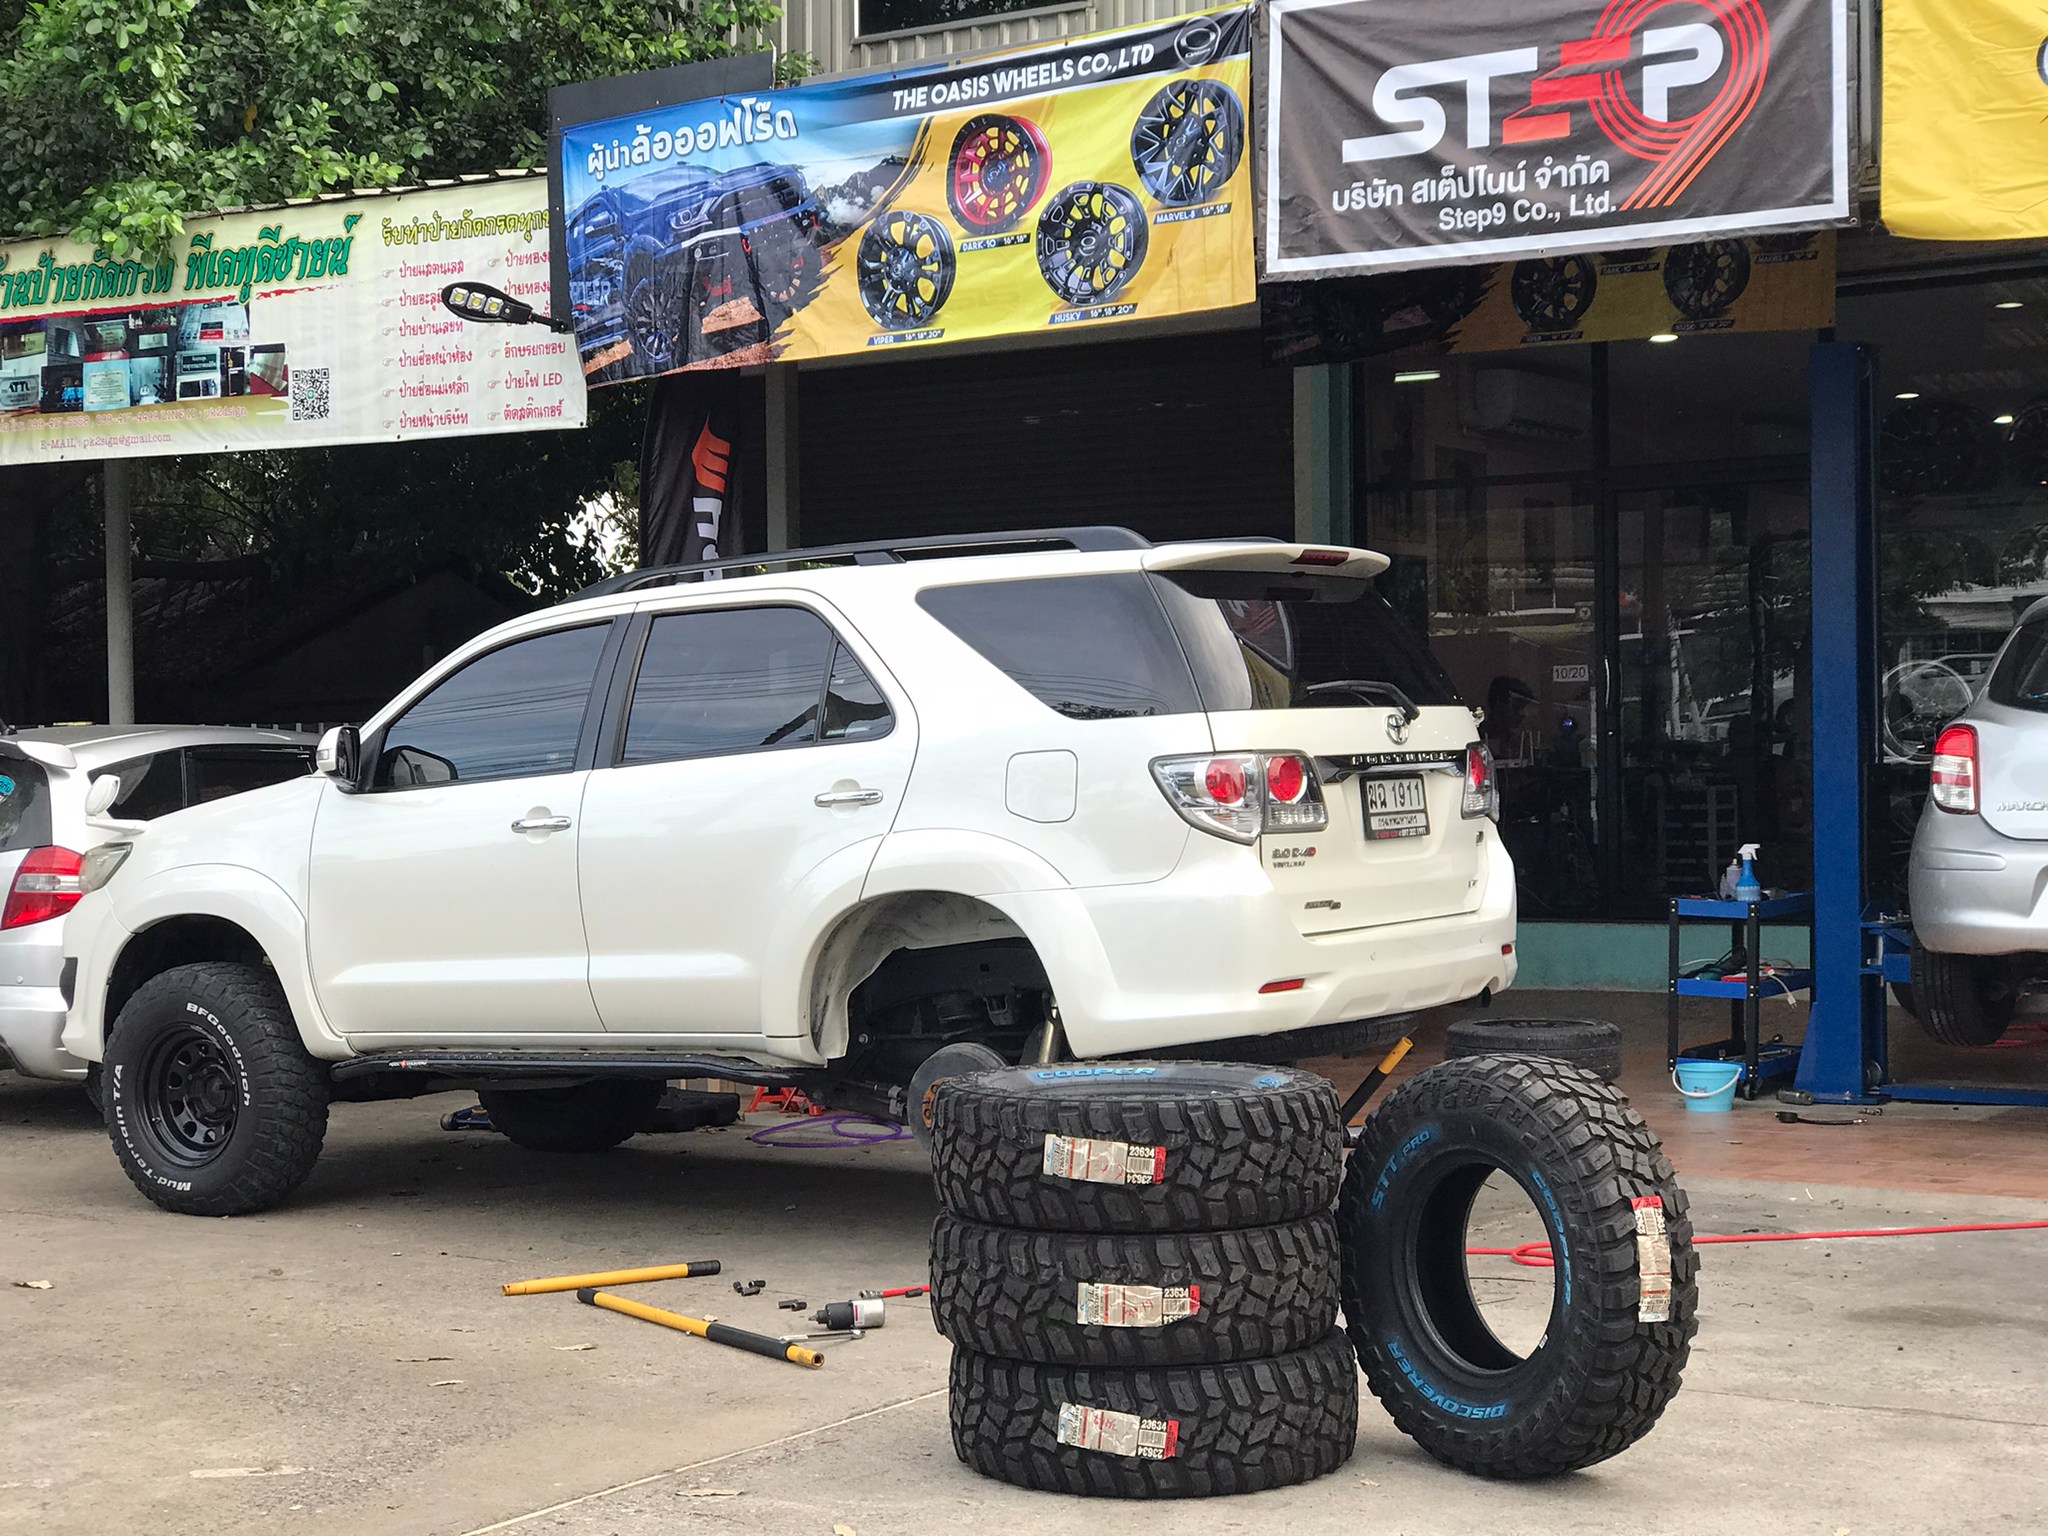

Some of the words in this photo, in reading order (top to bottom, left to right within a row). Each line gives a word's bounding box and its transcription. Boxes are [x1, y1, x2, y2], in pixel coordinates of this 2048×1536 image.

[892, 86, 928, 111] THE
[931, 77, 989, 105] OASIS
[993, 60, 1074, 95] WHEELS
[1077, 43, 1155, 80] CO.,LTD
[1331, 178, 1404, 212] บริษัท
[1410, 161, 1527, 202] สเต็ปไนน์
[1534, 154, 1610, 190] จำกัด
[1155, 209, 1196, 223] MARVEL-8
[1438, 200, 1506, 231] Step9
[1512, 198, 1561, 224] Co.,
[1569, 190, 1617, 216] Ltd.
[962, 238, 997, 252] DARK-10
[0, 247, 175, 310] ้านป้ายกัดกรด
[1054, 311, 1082, 323] HUSKY
[873, 335, 895, 345] VIPER
[399, 343, 473, 368] ป้ายชื่อหน้าห้อง
[398, 374, 470, 398] ป้ายชื่อแม่เหล็ก
[504, 369, 539, 390] ป้ายไฟ
[542, 372, 563, 387] LED
[399, 408, 469, 429] ป้ายหน้าบริษัท
[1554, 666, 1586, 680] 10/20
[1391, 780, 1421, 808] 1911
[186, 1002, 251, 1107] BFGoodrich
[113, 1064, 123, 1101] T/A
[1037, 1066, 1157, 1080] COOPER
[1128, 1145, 1155, 1158] 23634
[1371, 1154, 1399, 1210] STT
[1403, 1129, 1430, 1161] PRO
[1164, 1287, 1190, 1298] 23634
[1386, 1339, 1506, 1419] DISCOVERER
[1141, 1419, 1167, 1432] 23634
